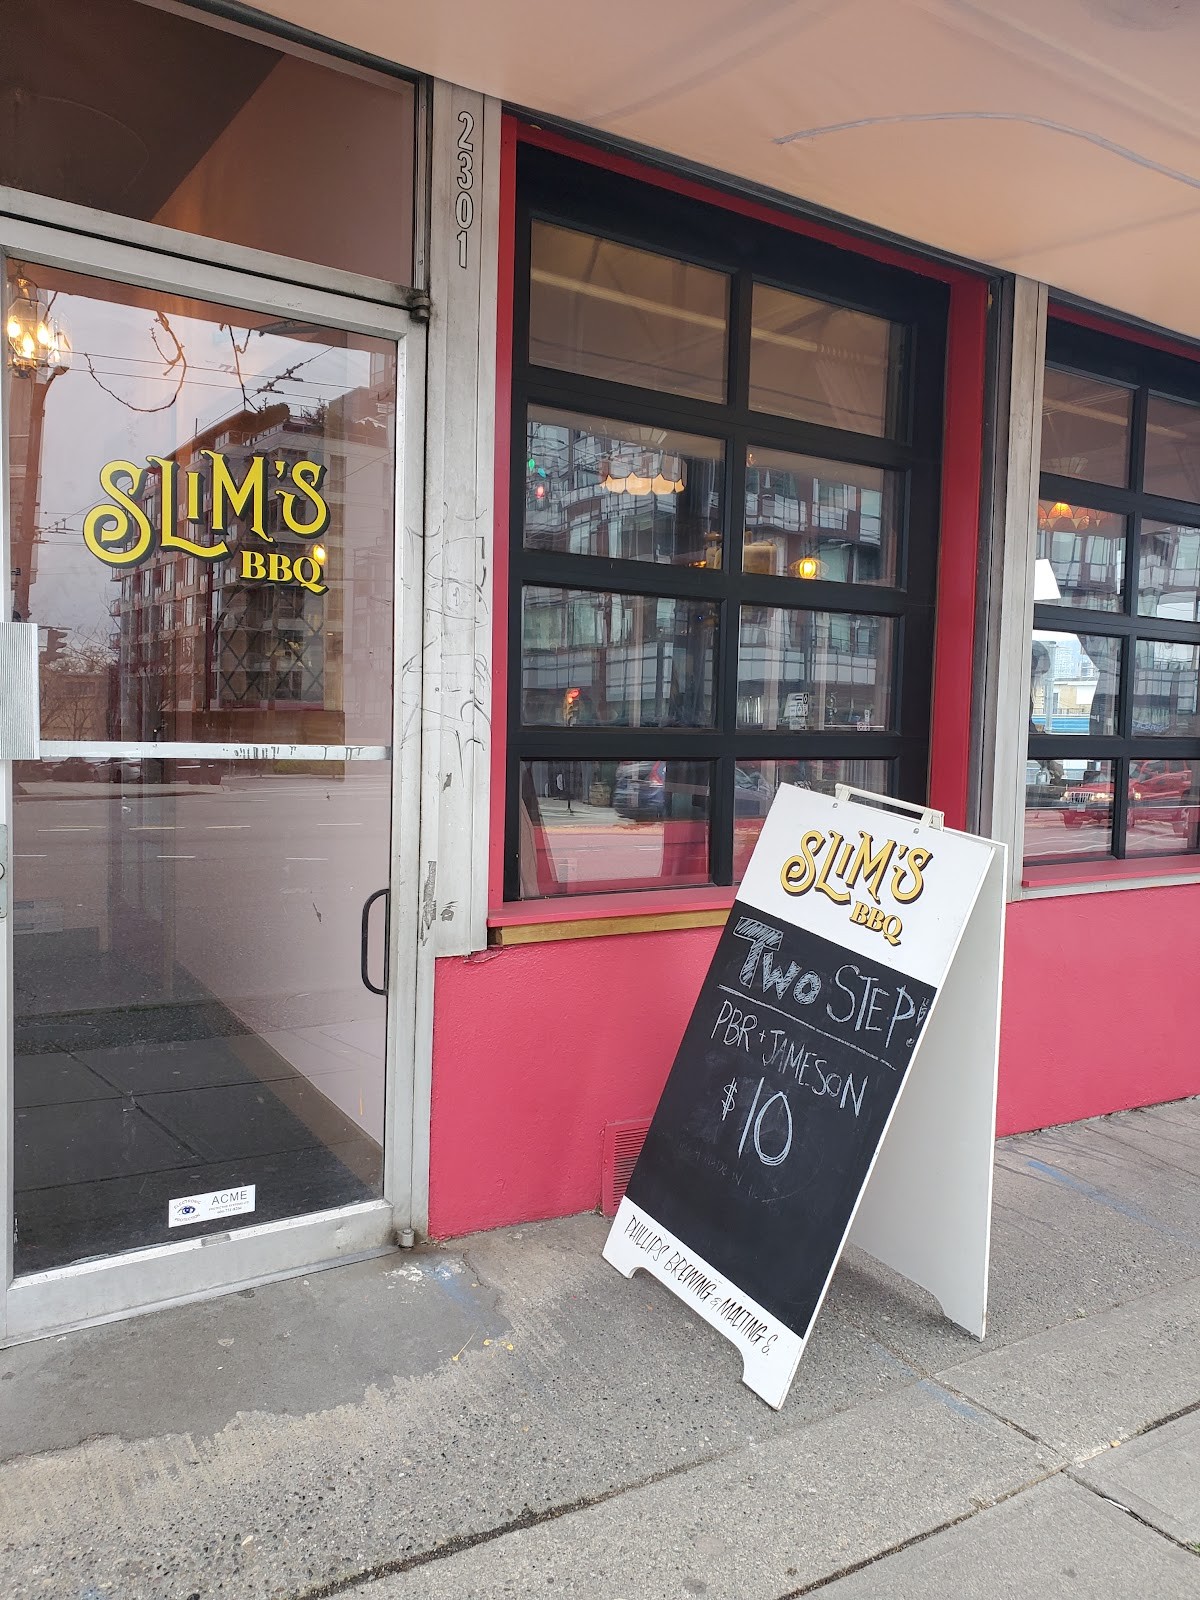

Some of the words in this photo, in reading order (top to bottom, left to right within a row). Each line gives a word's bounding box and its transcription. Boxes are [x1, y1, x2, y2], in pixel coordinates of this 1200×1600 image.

[455, 110, 475, 269] 2301
[83, 449, 331, 568] SLIM'S
[240, 550, 329, 596] BBQ
[780, 829, 934, 905] SLIM'S
[849, 901, 903, 947] BBQ
[711, 999, 757, 1052] PBR
[762, 1029, 868, 1118] JAMESON
[211, 1190, 248, 1206] ACME
[624, 1214, 670, 1262] PHILLIPS
[663, 1251, 718, 1303] BREWING
[716, 1297, 768, 1347] MALTING
